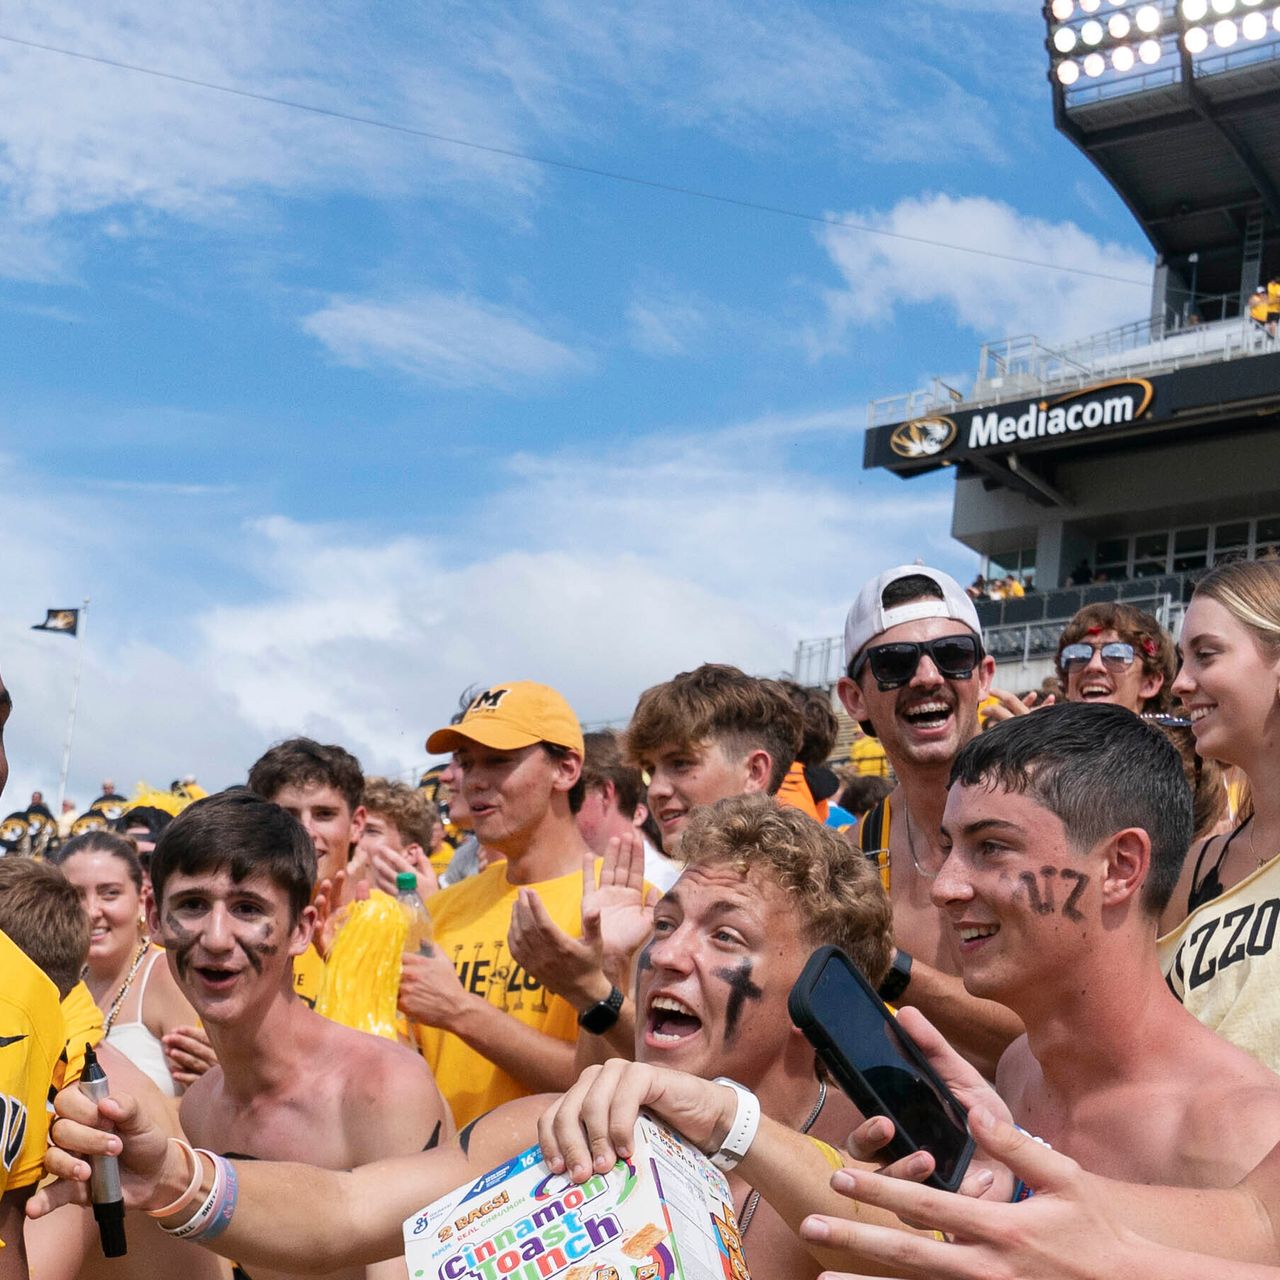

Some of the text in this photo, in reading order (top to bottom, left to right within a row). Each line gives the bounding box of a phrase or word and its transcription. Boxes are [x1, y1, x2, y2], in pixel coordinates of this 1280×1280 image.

[968, 396, 1133, 448] Mediacom
[471, 688, 512, 712] M
[437, 1189, 510, 1243] 2 BAGS!
